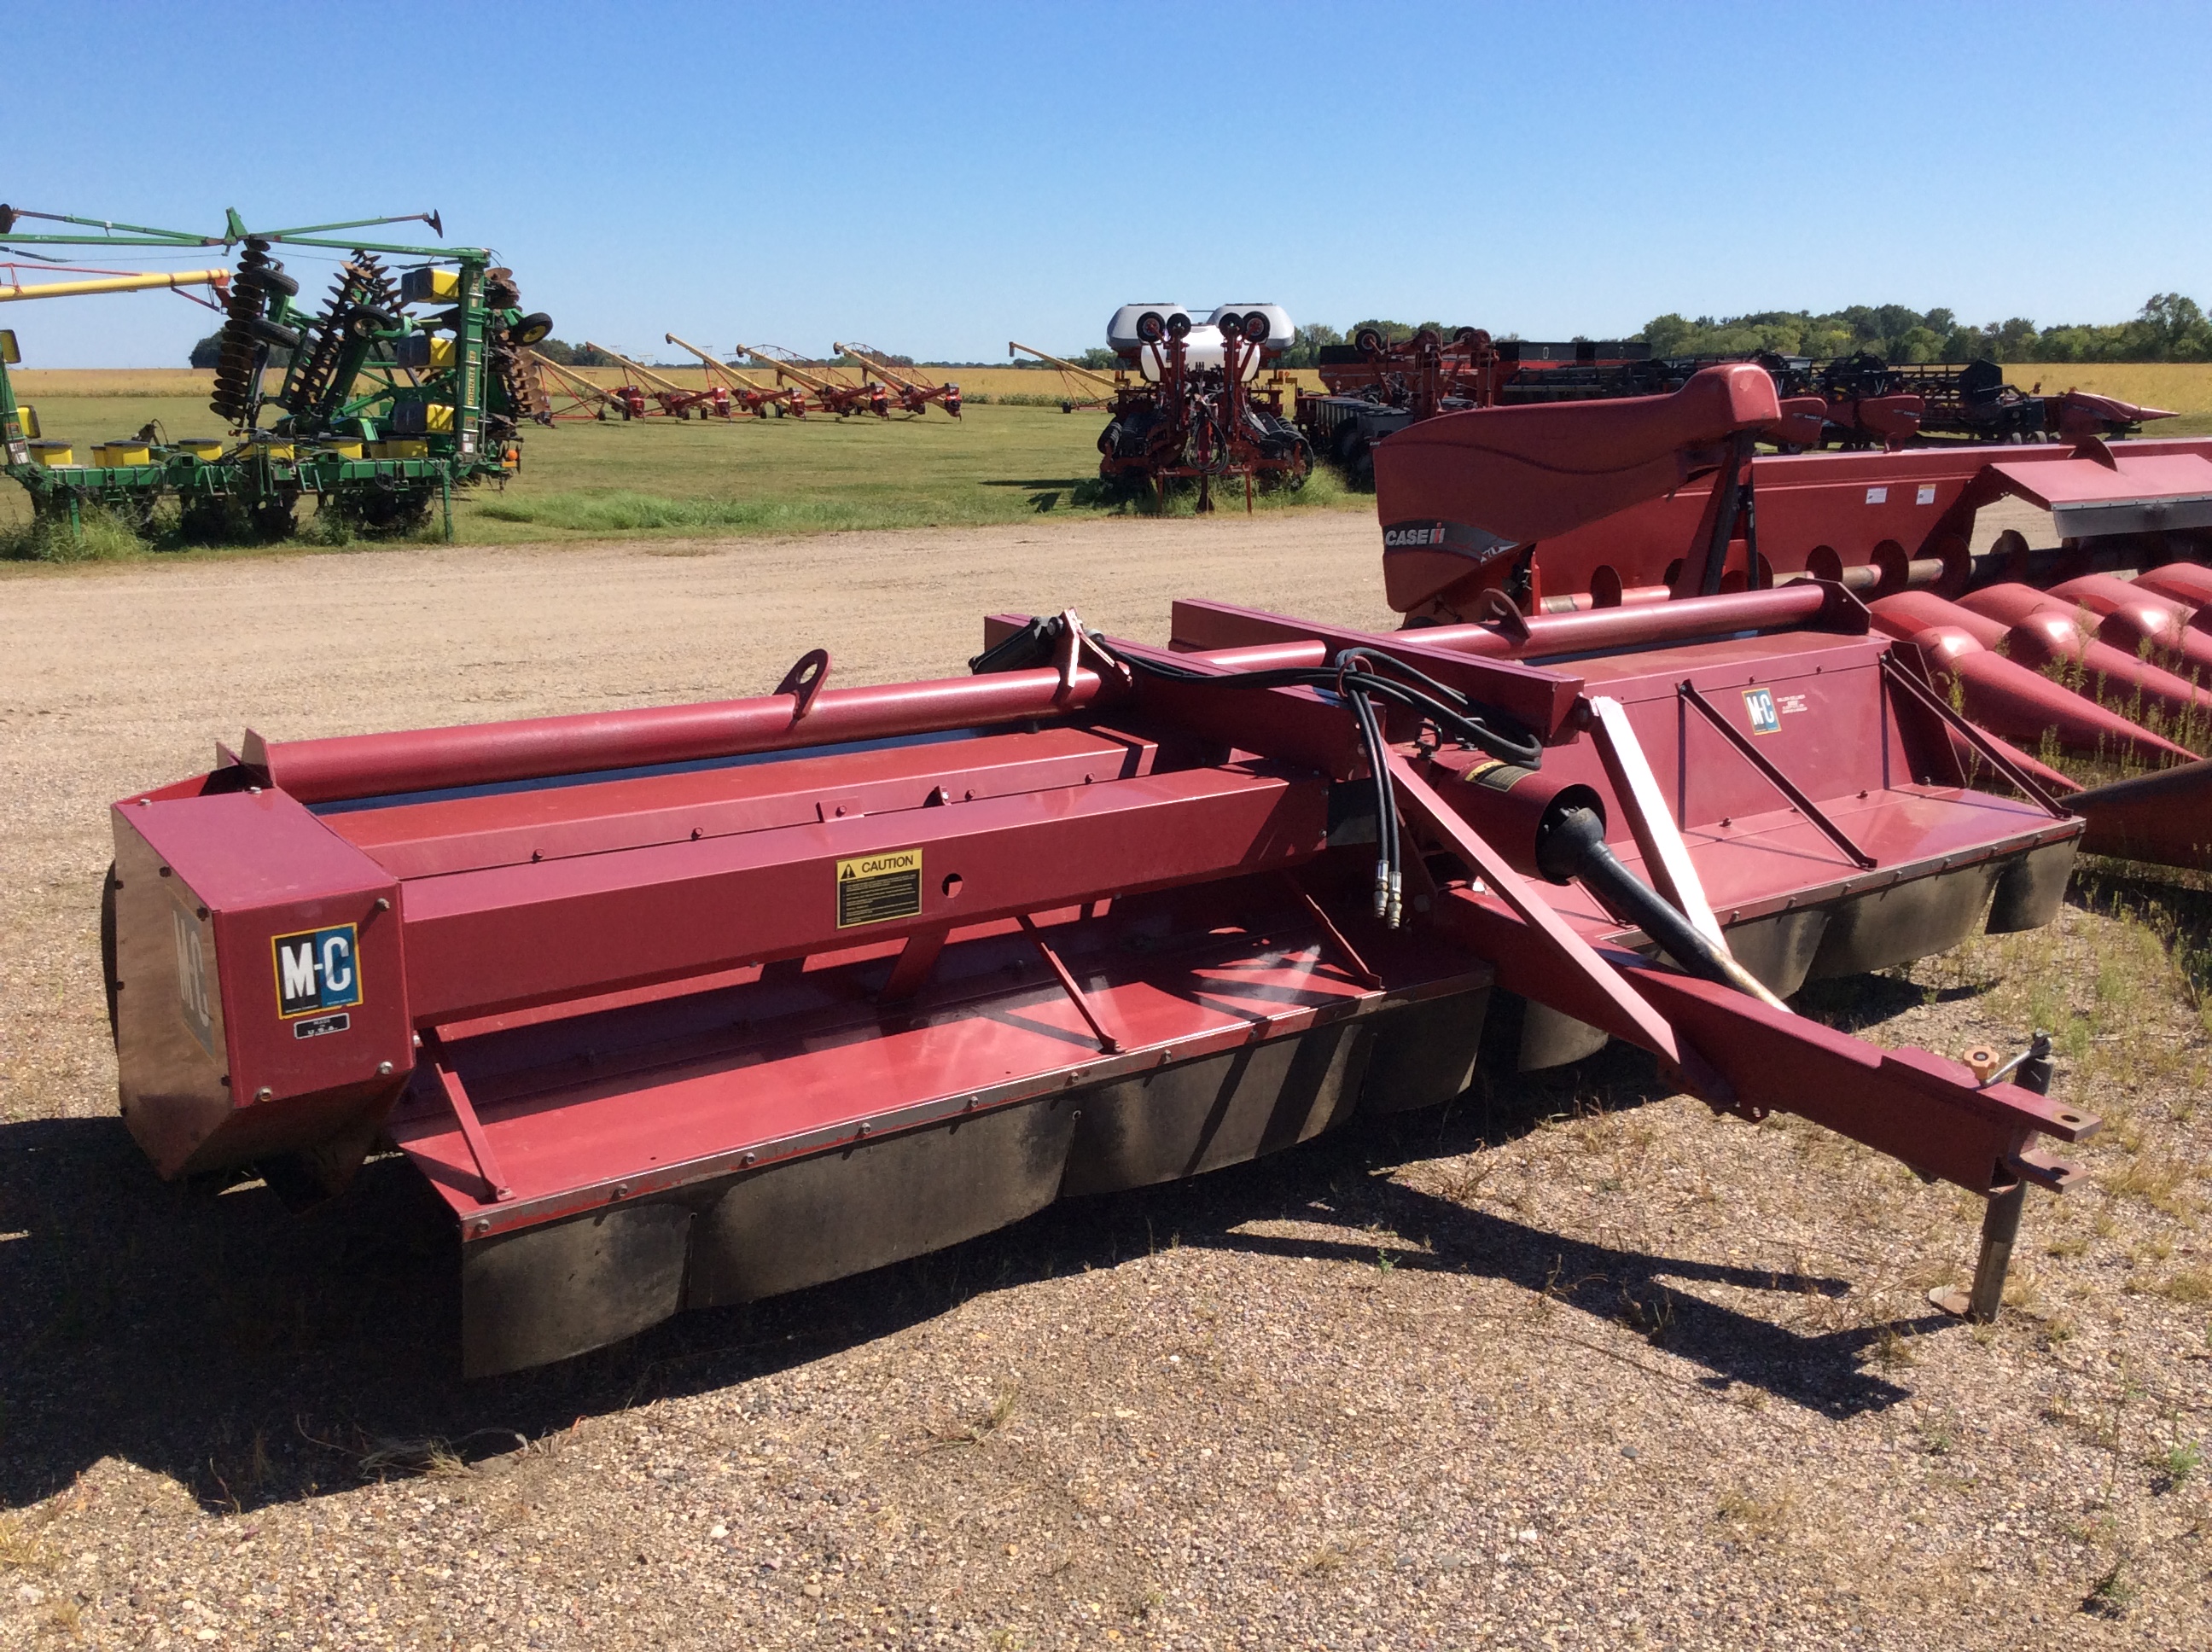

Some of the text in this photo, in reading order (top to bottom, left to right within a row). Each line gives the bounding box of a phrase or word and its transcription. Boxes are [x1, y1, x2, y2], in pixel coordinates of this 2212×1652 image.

[1385, 529, 1429, 546] CASE
[1746, 694, 1775, 725] M-C
[861, 855, 914, 873] CAUTION
[281, 936, 352, 1000] M-C
